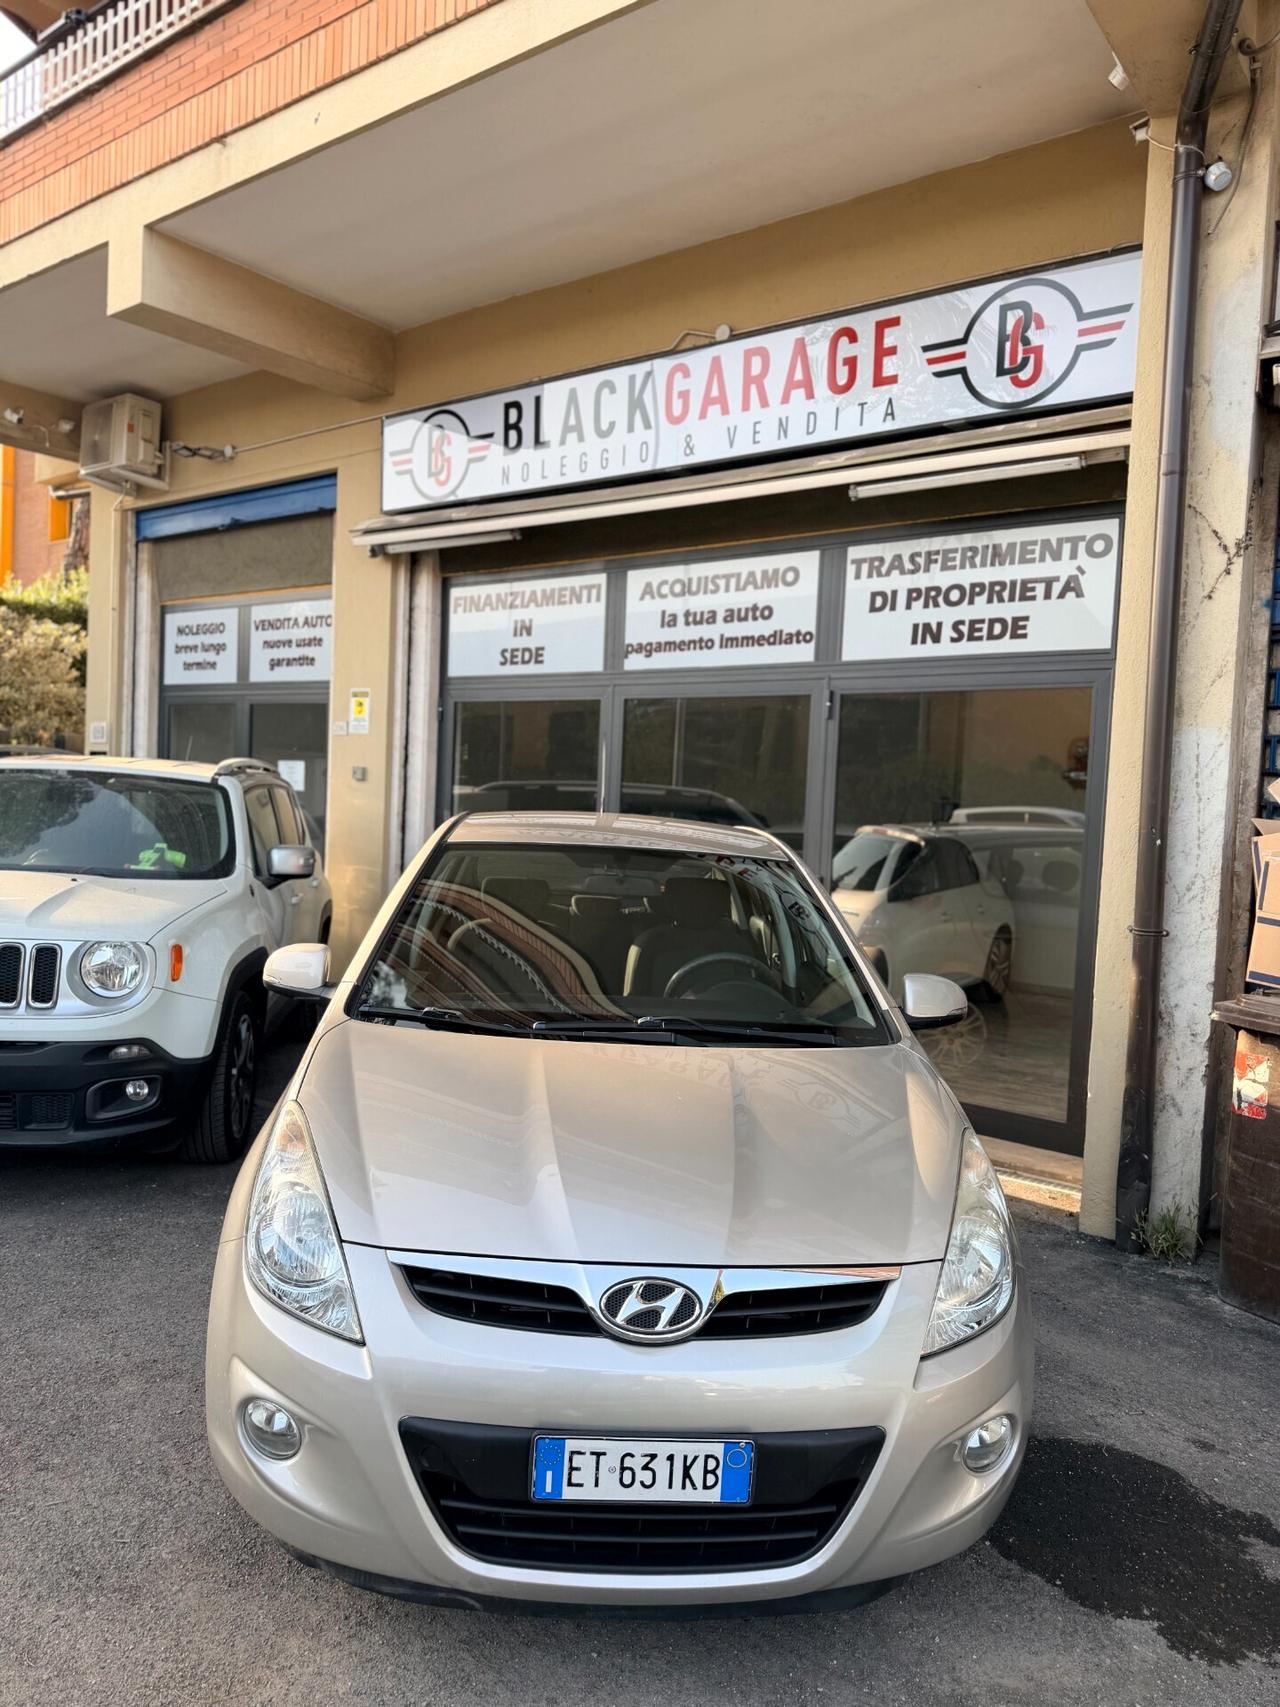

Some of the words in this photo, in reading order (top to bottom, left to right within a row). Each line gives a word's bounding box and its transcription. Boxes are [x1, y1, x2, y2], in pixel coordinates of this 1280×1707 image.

[501, 440, 649, 487] NOLEGGIO
[683, 433, 695, 457] &
[726, 396, 896, 449] VENDITA
[850, 532, 1114, 581] TRASFERIMENTO
[638, 565, 801, 602] ACQUISTIAMO
[868, 589, 898, 614] DI
[904, 564, 1087, 611] PROPRIETÀ
[453, 583, 603, 615] FINANZIAMENTI
[253, 617, 300, 632] VENDITA
[660, 609, 678, 629] la
[683, 608, 717, 627] tua
[722, 602, 774, 624] auto
[176, 622, 226, 637] NOLEGGIO
[512, 618, 534, 638] IN
[909, 621, 944, 646] IN
[949, 615, 1030, 644] SEDE
[174, 642, 199, 655] breve
[200, 640, 227, 656] lungo
[262, 637, 293, 650] nuove
[295, 635, 324, 649] usate
[624, 636, 715, 659] pagamento
[719, 629, 815, 650] immediato
[183, 658, 217, 672] termine
[268, 653, 316, 672] garantite
[499, 646, 546, 666] SEDE
